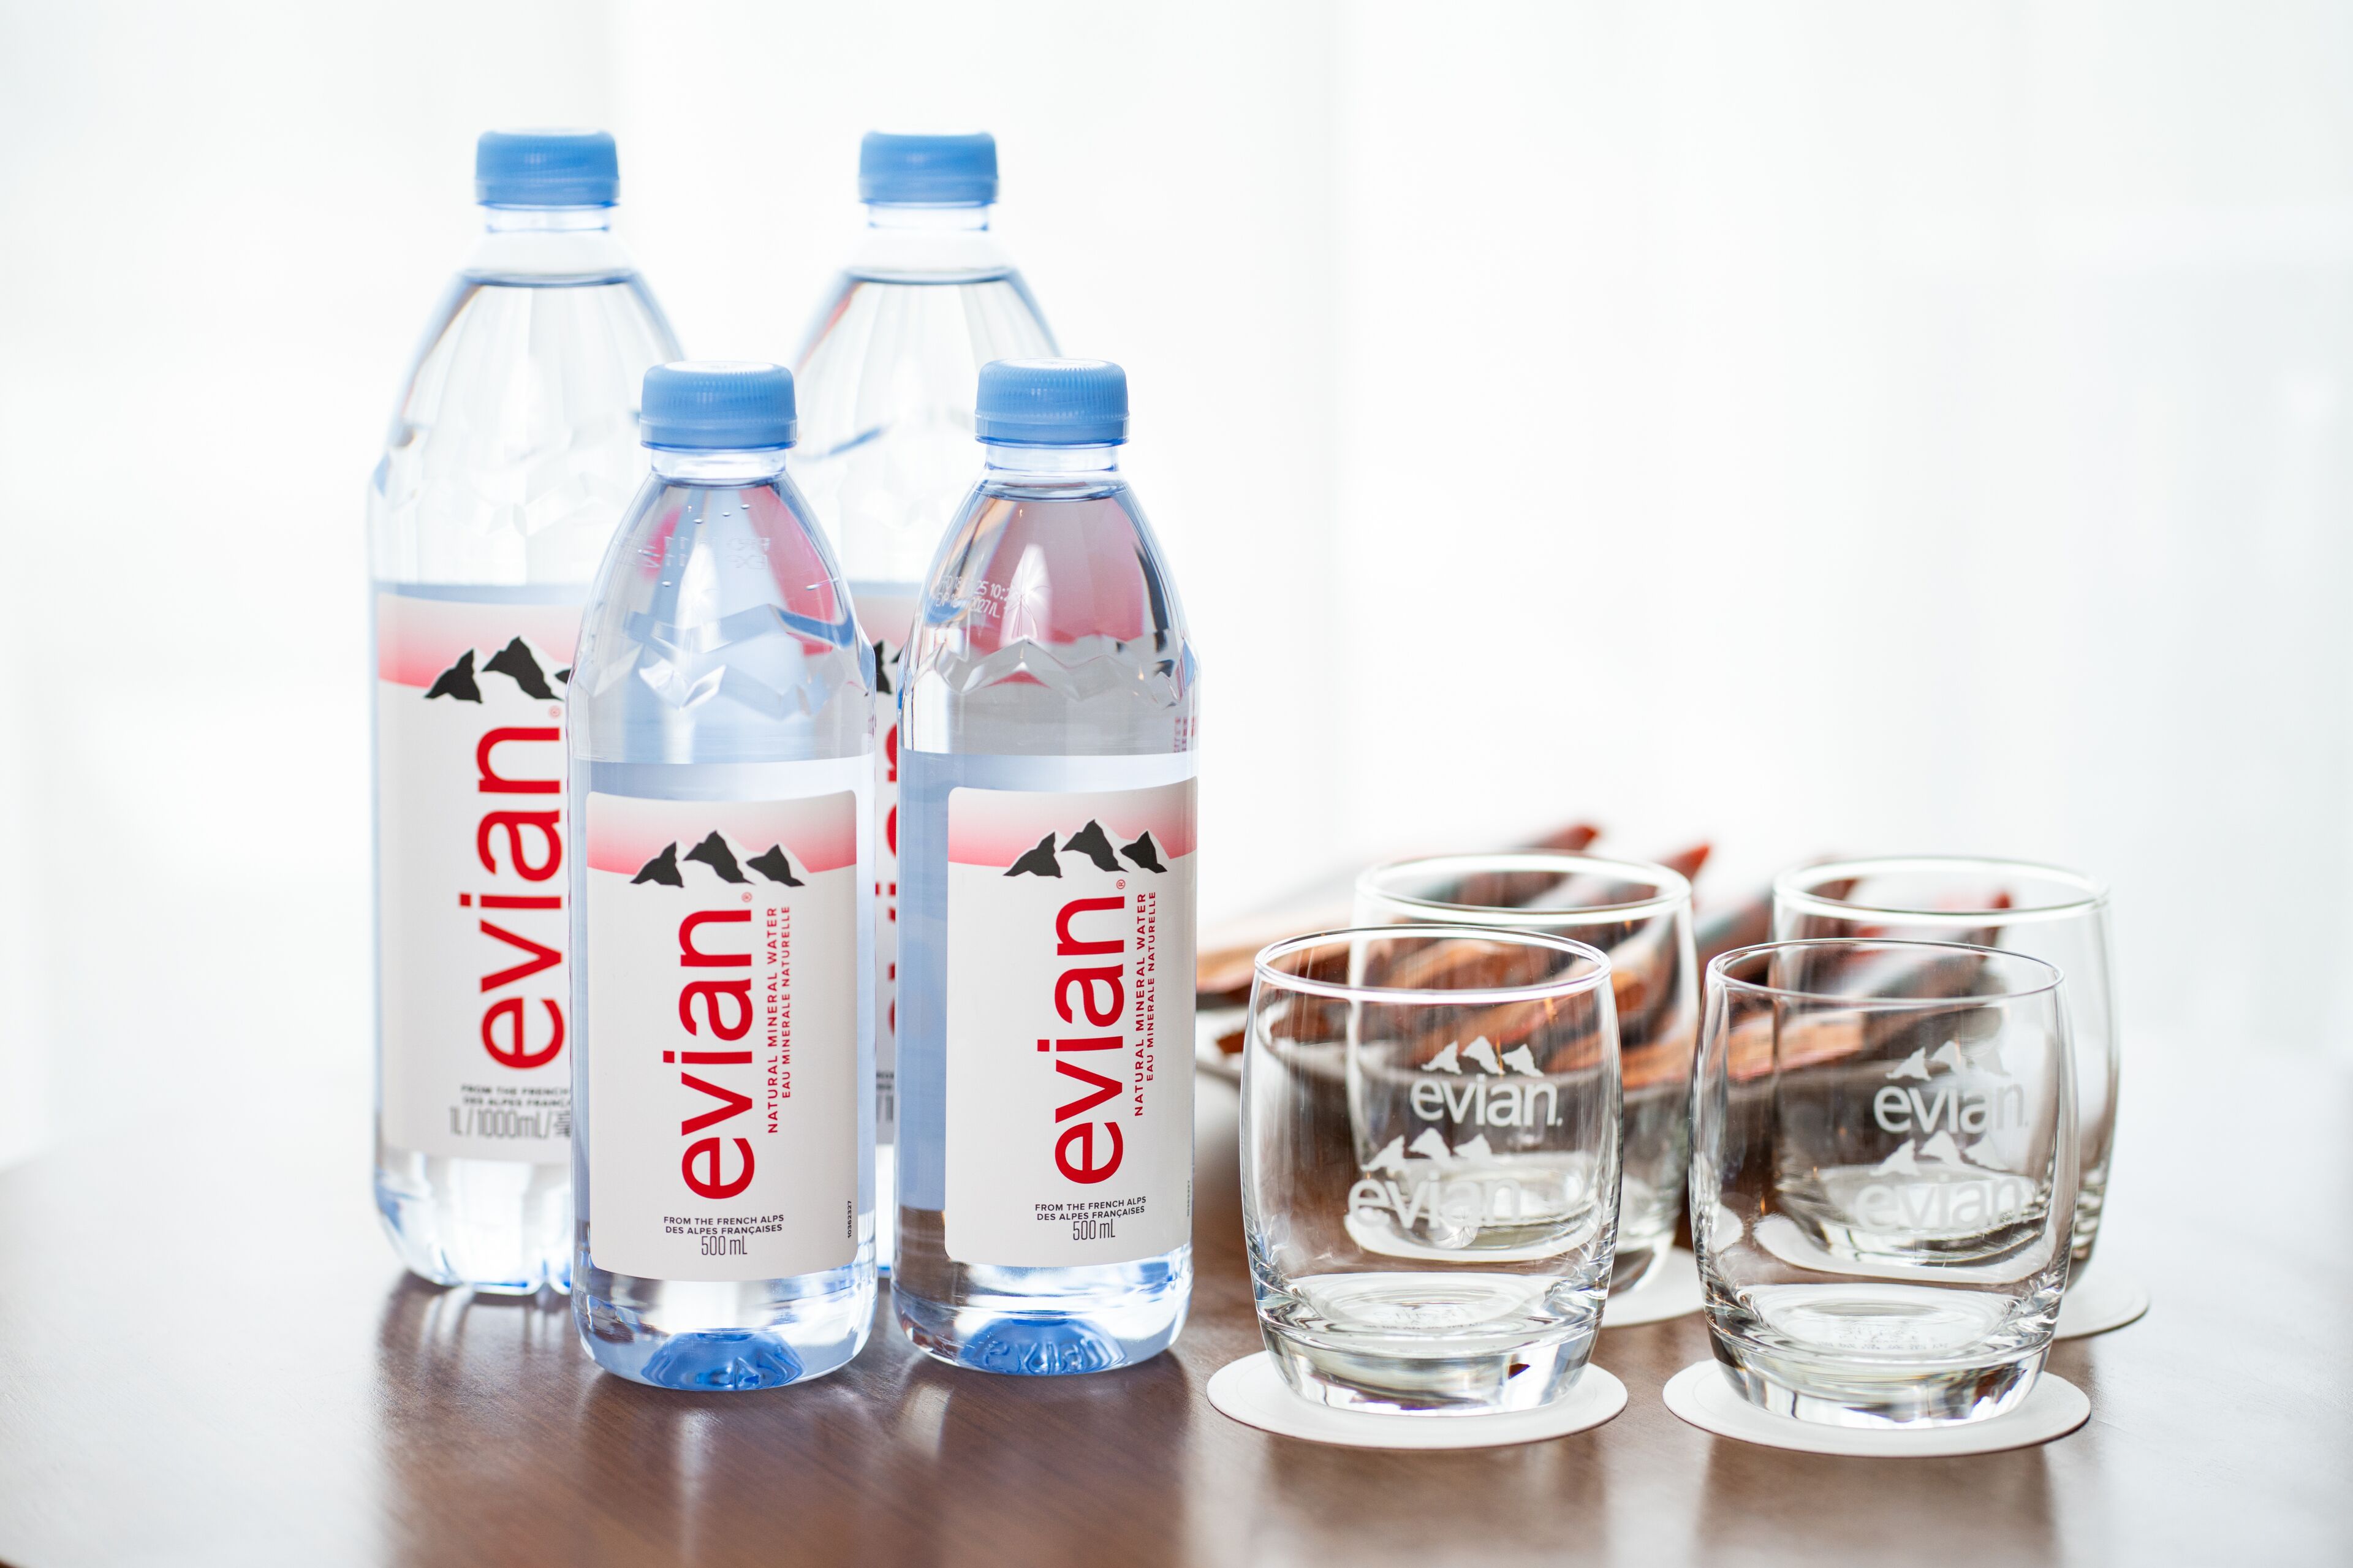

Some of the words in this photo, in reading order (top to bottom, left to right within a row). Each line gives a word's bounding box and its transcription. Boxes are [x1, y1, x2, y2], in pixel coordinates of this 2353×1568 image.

[459, 727, 565, 1070] evian
[1137, 893, 1146, 950] WATER
[766, 907, 778, 964] WATER
[781, 907, 790, 987] NATURELLE
[767, 973, 778, 1047] MINERAL
[1135, 958, 1145, 1032] MINERAL
[662, 909, 755, 1200] evian
[781, 994, 790, 1064] MINERALE
[1037, 895, 1125, 1184] evian
[767, 1055, 778, 1134] NATURAL
[781, 1071, 790, 1098] EAU
[1135, 1039, 1144, 1117] NATURAL
[664, 1216, 691, 1225] FROM
[717, 1217, 757, 1225] FRENCH
[760, 1214, 784, 1224] ALPS
[1073, 1220, 1096, 1240] 500
[1099, 1218, 1116, 1239] mL
[1088, 1199, 1124, 1210] FRENCH
[1127, 1196, 1146, 1206] ALPS
[1092, 1206, 1145, 1218] FRANÇAISES
[1348, 1169, 1521, 1229] evian
[702, 1235, 726, 1256] 500
[730, 1235, 748, 1255] mL
[721, 1224, 782, 1235] FRANÇAISES
